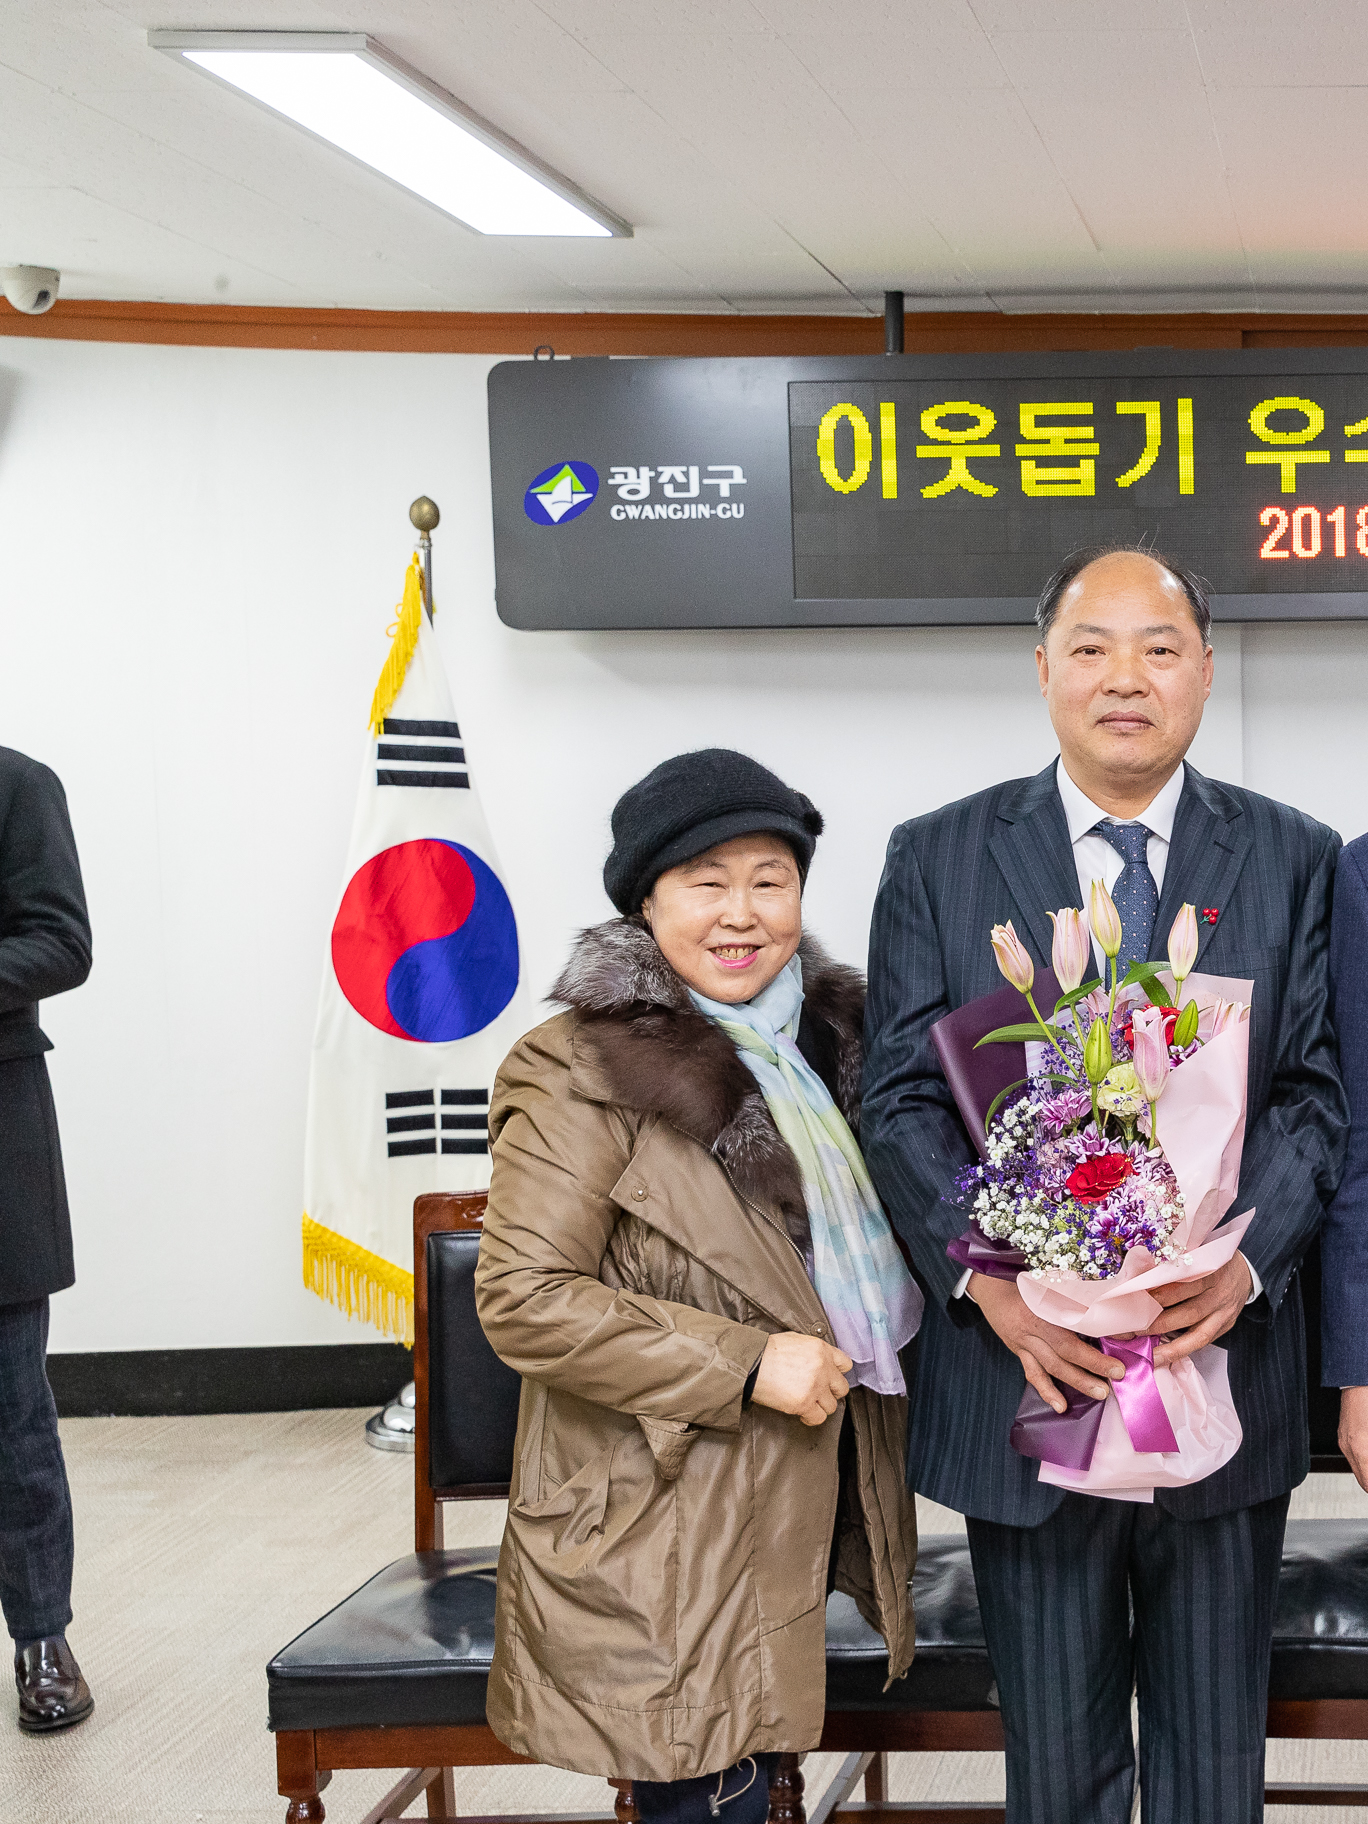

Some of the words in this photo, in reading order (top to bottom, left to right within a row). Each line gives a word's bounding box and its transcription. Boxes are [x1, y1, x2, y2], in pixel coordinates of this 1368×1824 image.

[816, 397, 1196, 500] 이웃돕기
[606, 463, 749, 500] 광진구
[609, 502, 746, 521] GWANGJIN-GU
